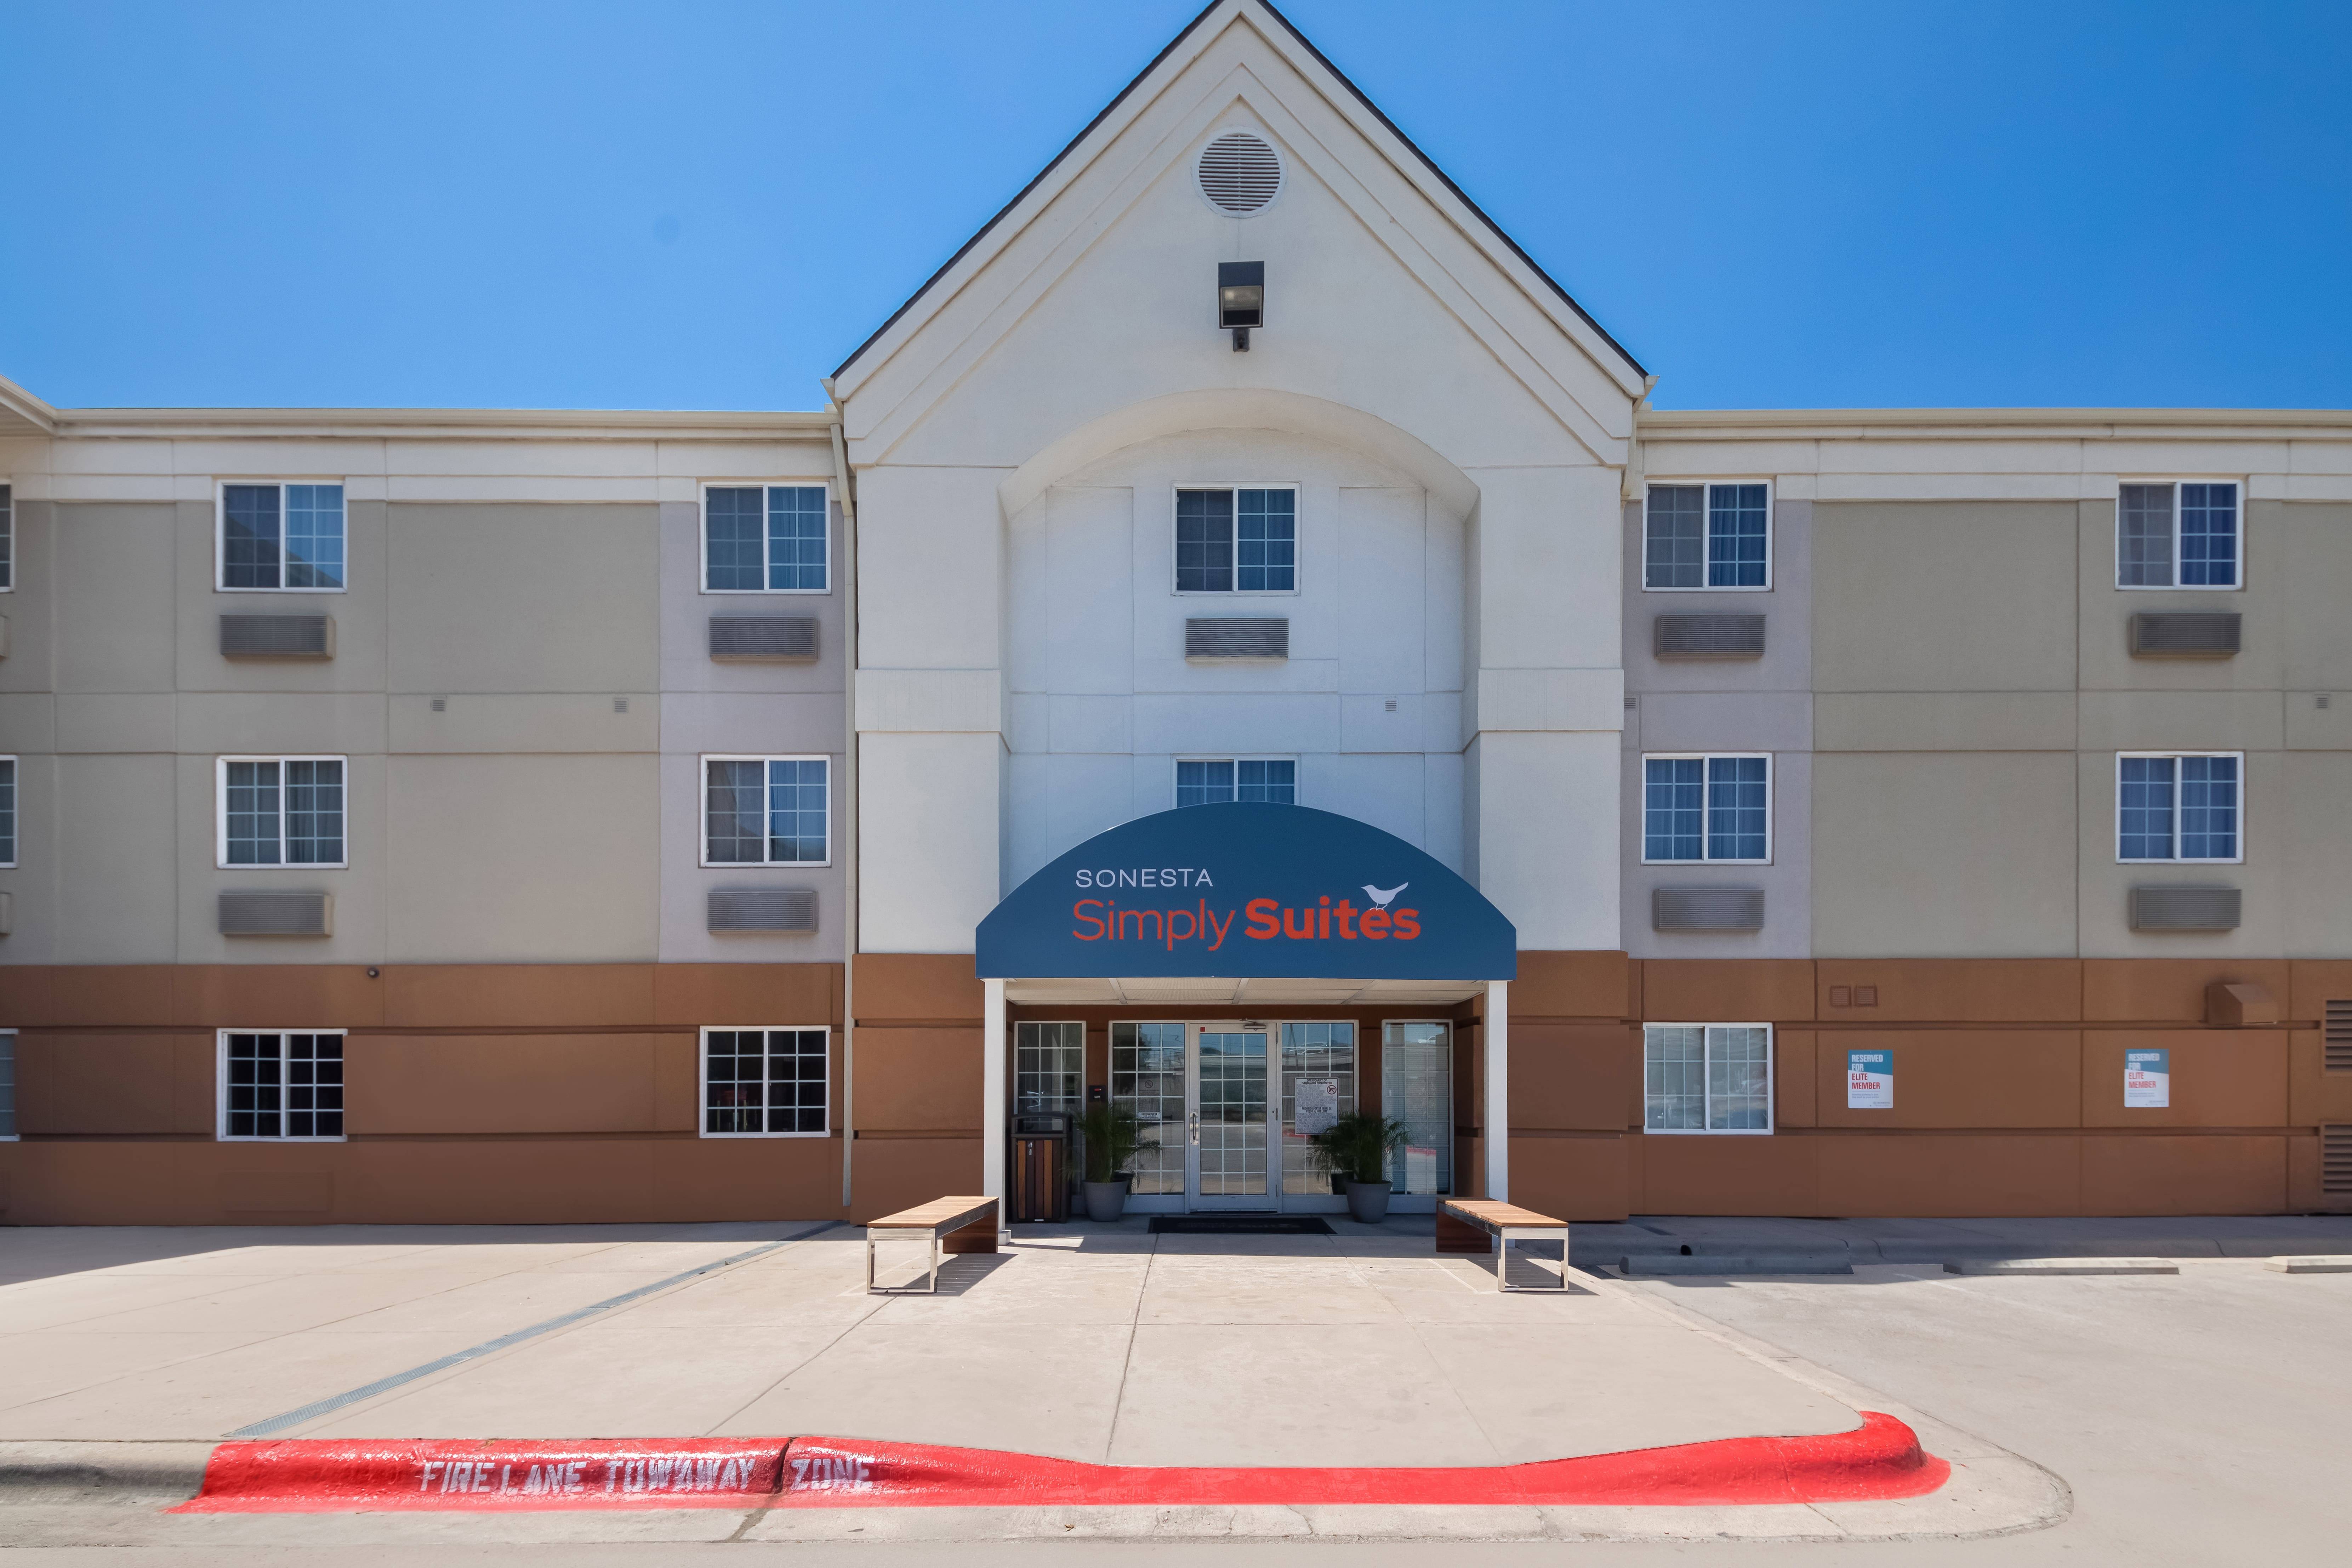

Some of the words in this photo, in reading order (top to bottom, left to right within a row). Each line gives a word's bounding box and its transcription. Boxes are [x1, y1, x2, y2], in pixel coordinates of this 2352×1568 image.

[1075, 868, 1213, 888] SONESTA
[1073, 898, 1235, 951] Simply
[1244, 896, 1421, 940] Suites
[1852, 1063, 1864, 1071] FOR
[420, 1461, 495, 1493] FIRE
[500, 1461, 587, 1495] LANE
[605, 1458, 756, 1493] TOWAWAY
[790, 1456, 875, 1490] ZONE
